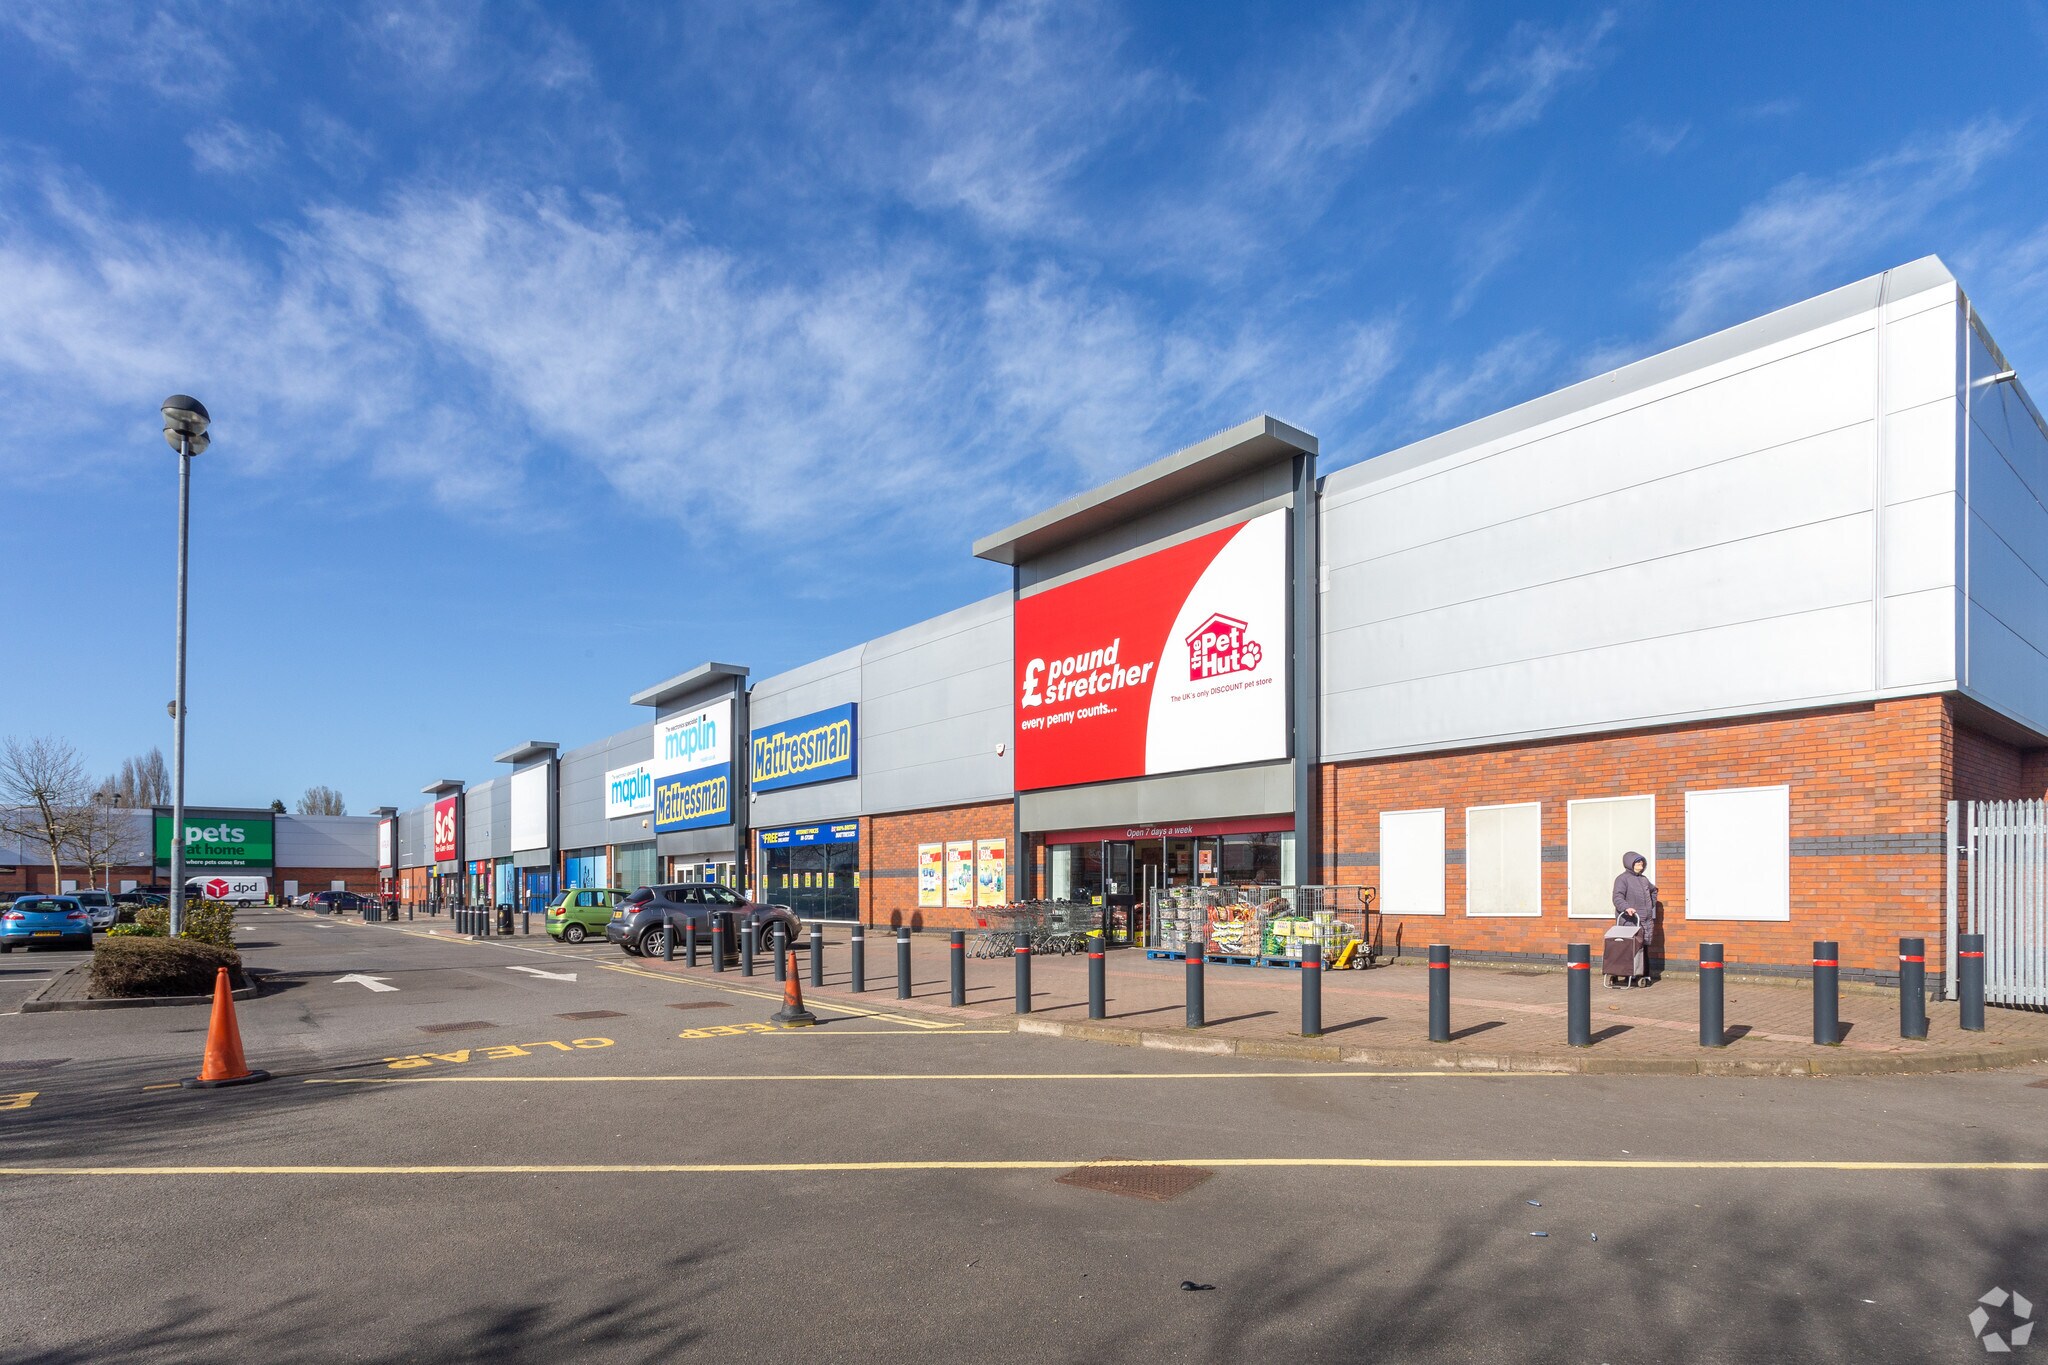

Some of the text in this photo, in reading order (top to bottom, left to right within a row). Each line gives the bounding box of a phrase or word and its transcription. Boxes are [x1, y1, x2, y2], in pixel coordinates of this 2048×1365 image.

[1190, 640, 1202, 669] the
[1201, 626, 1240, 656] Pet
[1047, 637, 1121, 681] pound
[1201, 652, 1242, 677] Hut
[1044, 660, 1154, 705] stretcher
[1171, 695, 1181, 703] The
[1197, 689, 1210, 698] only
[1210, 682, 1243, 695] DISCOUNT
[1244, 680, 1254, 690] pet
[1255, 677, 1273, 686] store
[1021, 702, 1118, 730] every penny counts...
[665, 714, 716, 762] maplin
[753, 719, 850, 783] Mattressman
[611, 766, 651, 808] maplin
[656, 775, 728, 825] Mattressman
[185, 823, 246, 846] pets
[435, 806, 455, 845] ScS
[764, 832, 778, 844] FREE
[1127, 828, 1144, 838] Open
[1145, 828, 1150, 836] 7
[1151, 827, 1167, 838] days
[1174, 825, 1193, 834] week
[186, 843, 245, 855] at home
[233, 883, 258, 894] dpd
[678, 1022, 815, 1039] EEP
[382, 1036, 615, 1070] CLEAR
